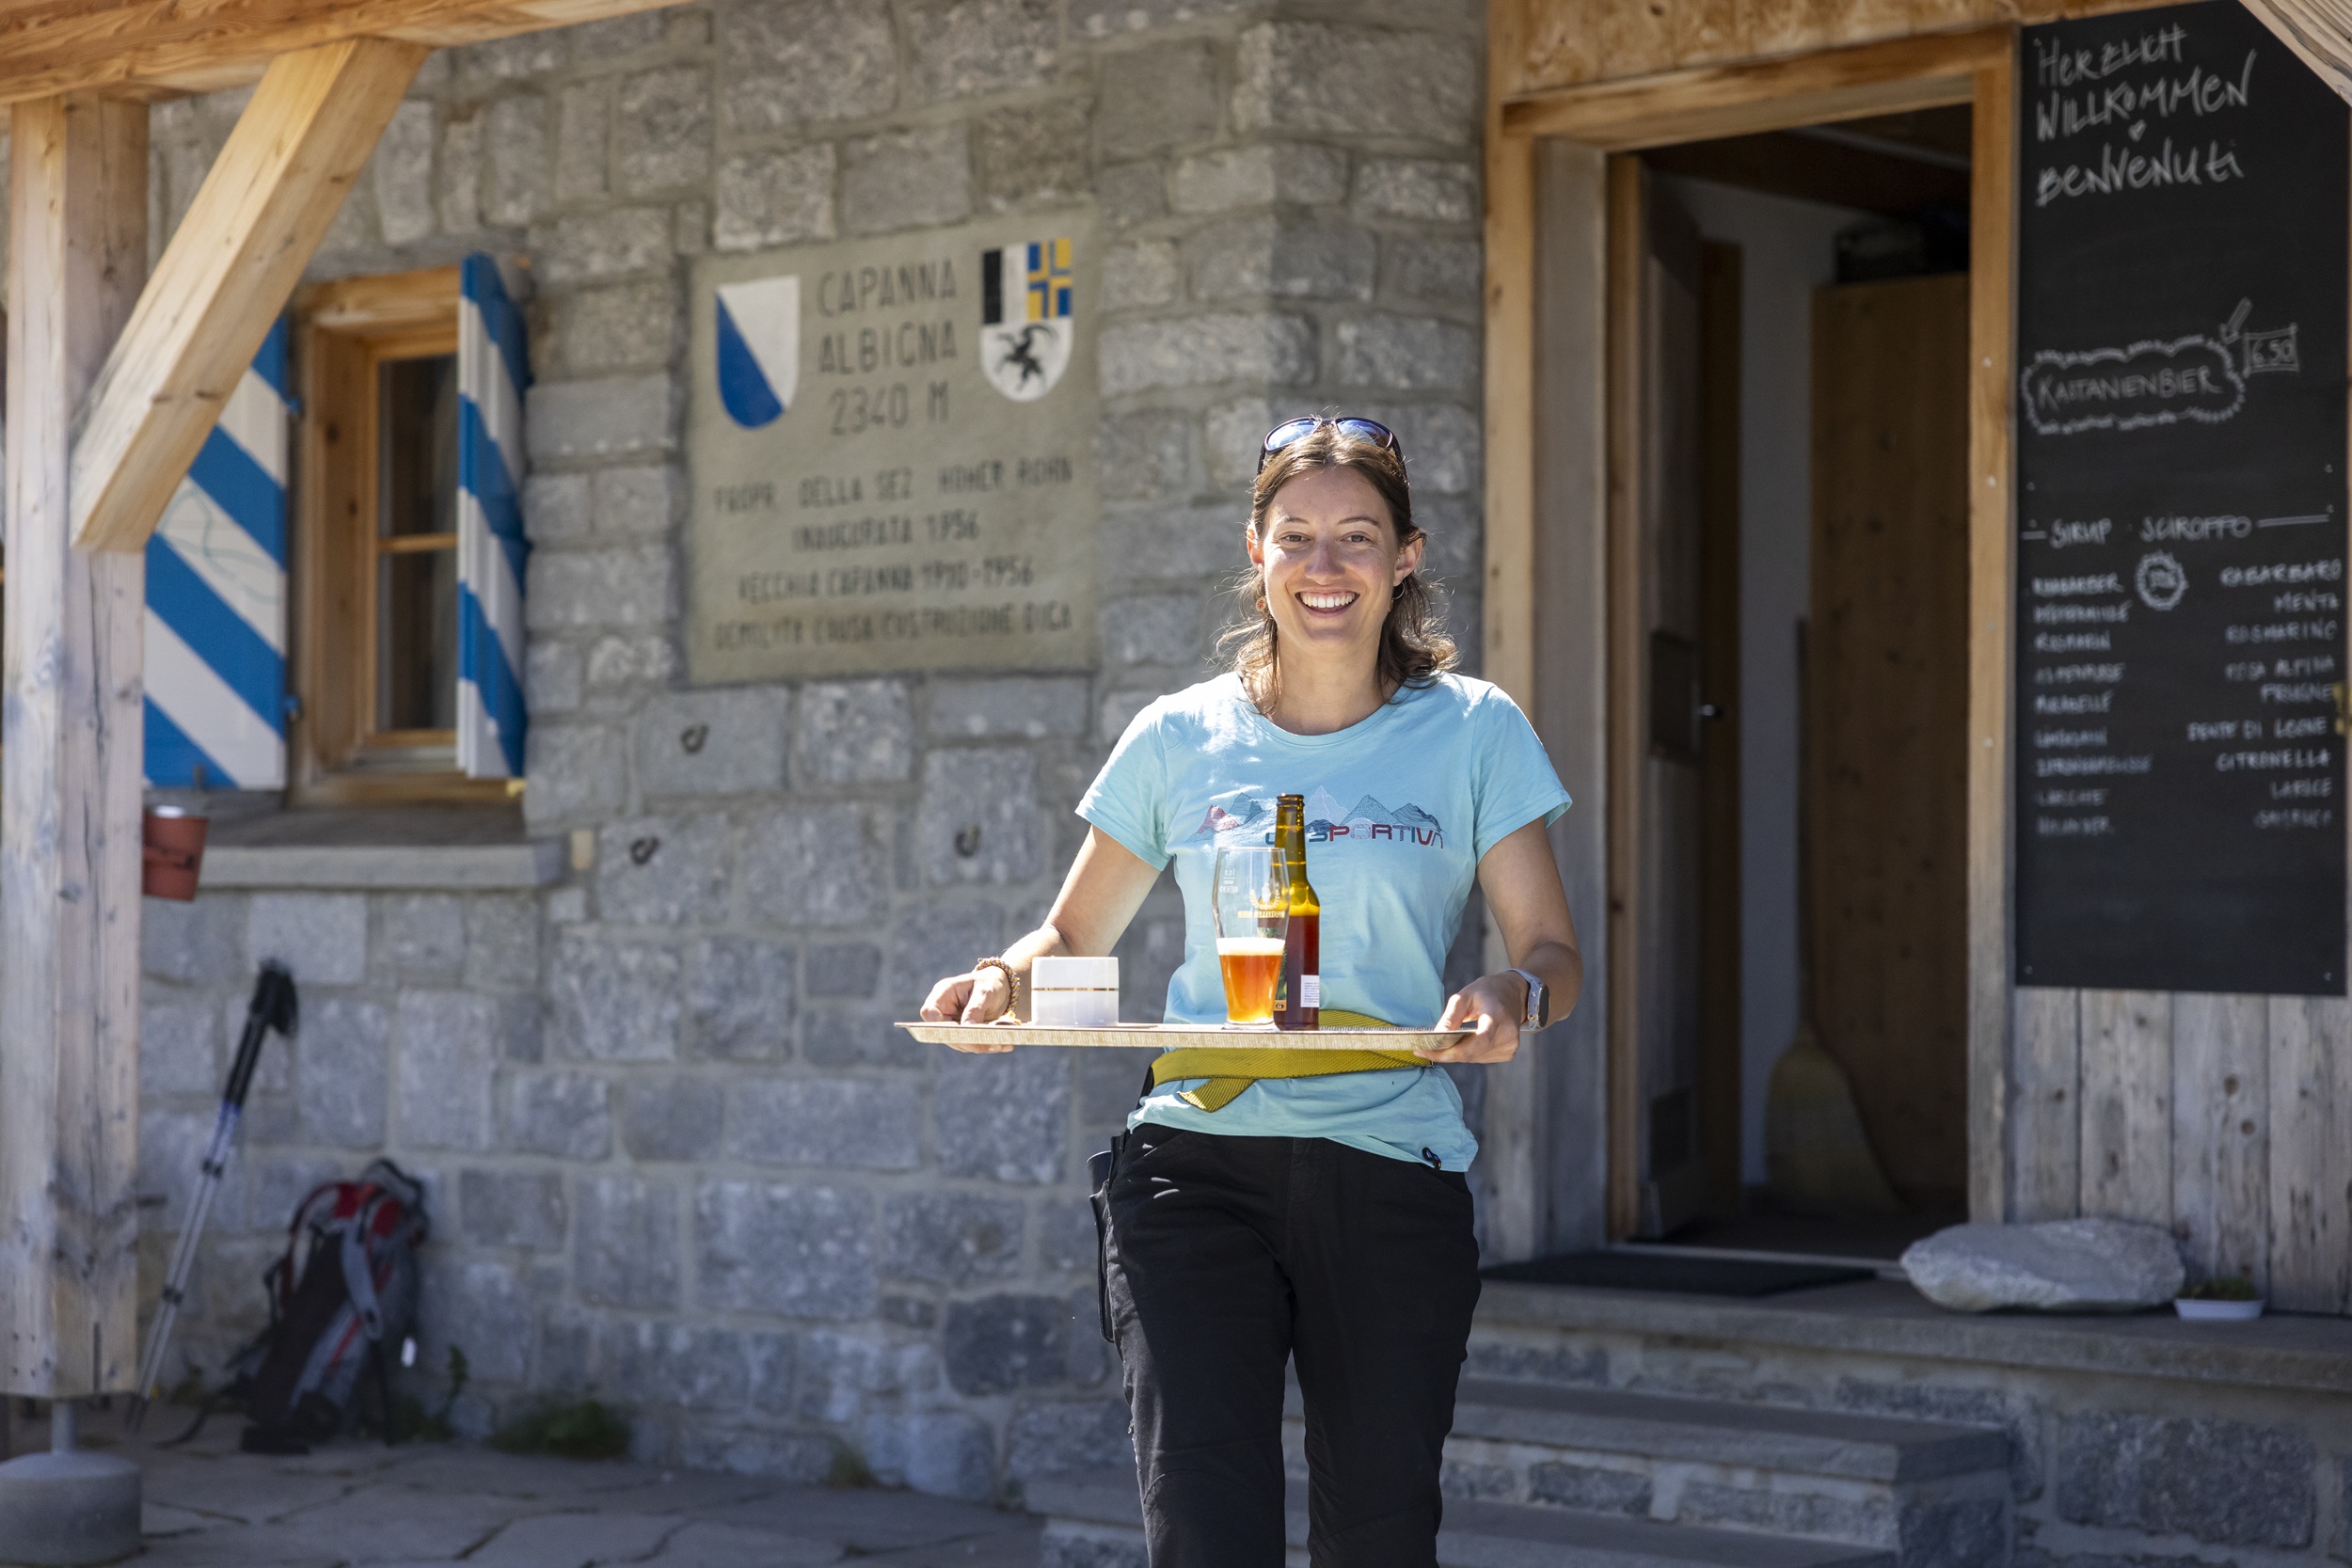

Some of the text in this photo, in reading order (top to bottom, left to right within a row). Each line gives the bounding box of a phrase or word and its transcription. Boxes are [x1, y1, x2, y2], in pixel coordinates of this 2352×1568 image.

[817, 259, 957, 318] CAPANNA
[818, 319, 958, 375] ALBIGNA
[830, 382, 950, 436] 2340 M
[799, 476, 864, 509] DELLA
[938, 459, 1004, 495] HOHER
[926, 508, 981, 543] 1956
[2049, 517, 2112, 548] SIRUP
[828, 562, 913, 598] CAPANNA
[2274, 588, 2341, 614] MENTA
[2224, 617, 2339, 646] ROSMARINO
[2215, 748, 2331, 773] CITRONELLA
